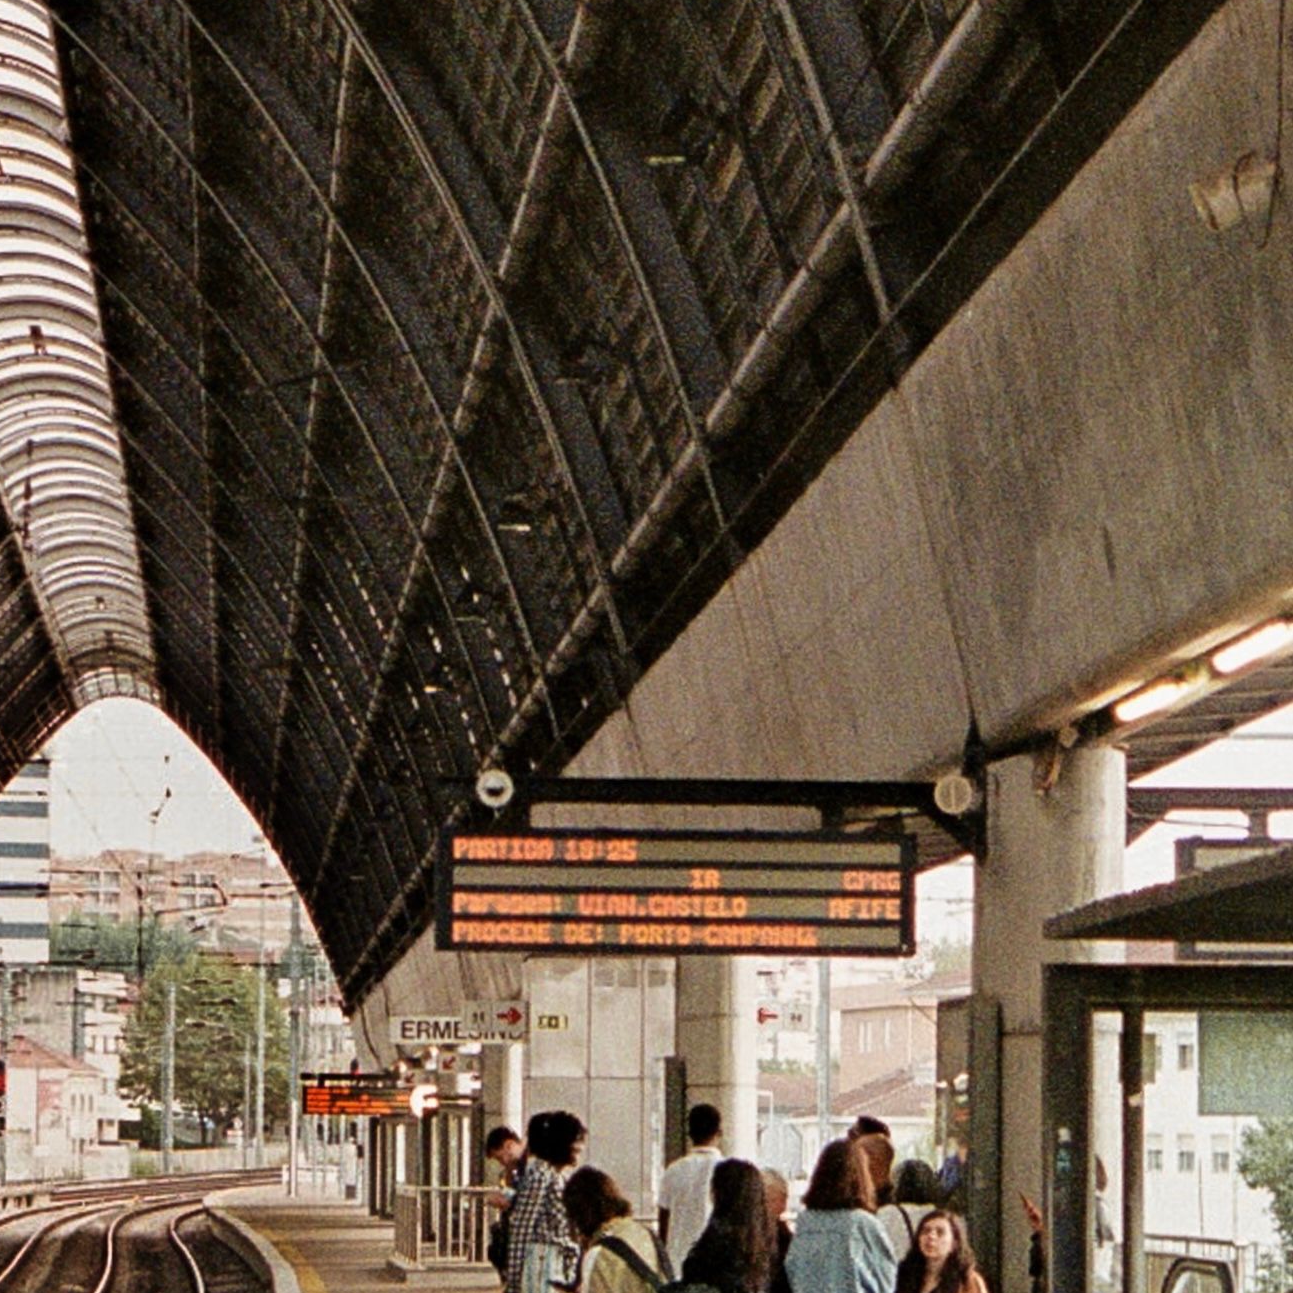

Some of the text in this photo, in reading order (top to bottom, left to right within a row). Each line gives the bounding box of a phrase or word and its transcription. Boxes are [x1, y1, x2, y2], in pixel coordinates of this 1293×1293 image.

[690, 868, 720, 889] IR
[827, 897, 901, 919] AFIFE
[452, 921, 552, 943] PROCEDE
[563, 923, 604, 944] DE:
